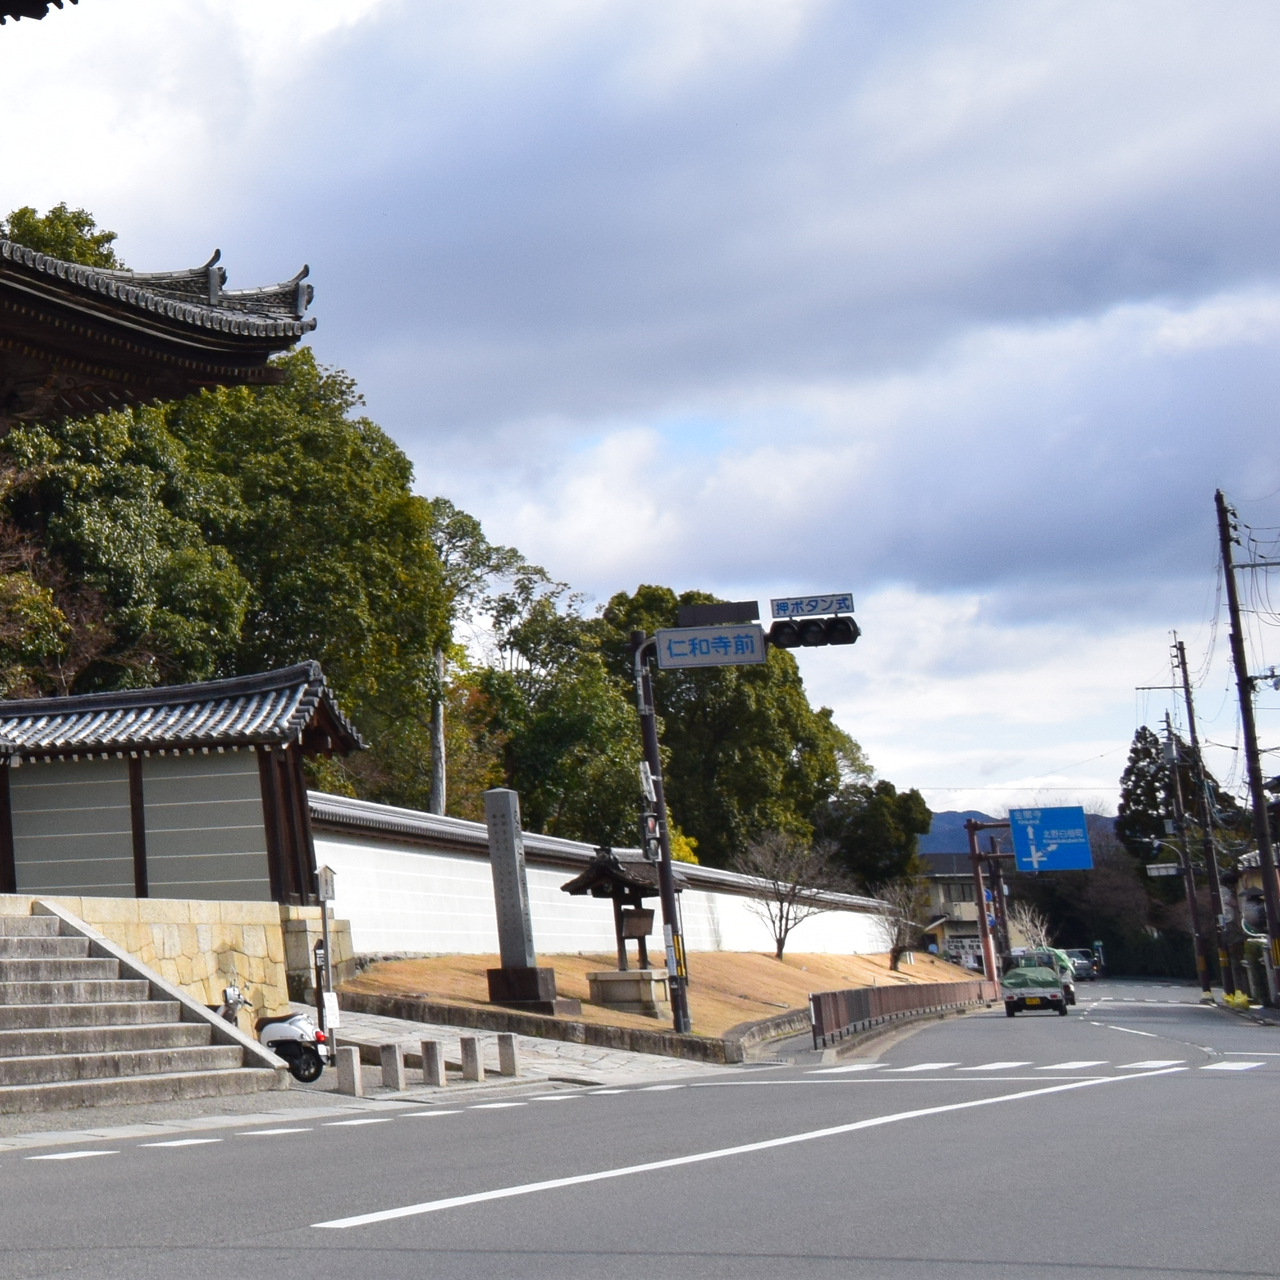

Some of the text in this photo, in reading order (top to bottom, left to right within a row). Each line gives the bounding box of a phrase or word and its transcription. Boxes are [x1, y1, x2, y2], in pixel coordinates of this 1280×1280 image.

[775, 597, 850, 615] 押ボタン式
[667, 633, 755, 658] 仁和寺前
